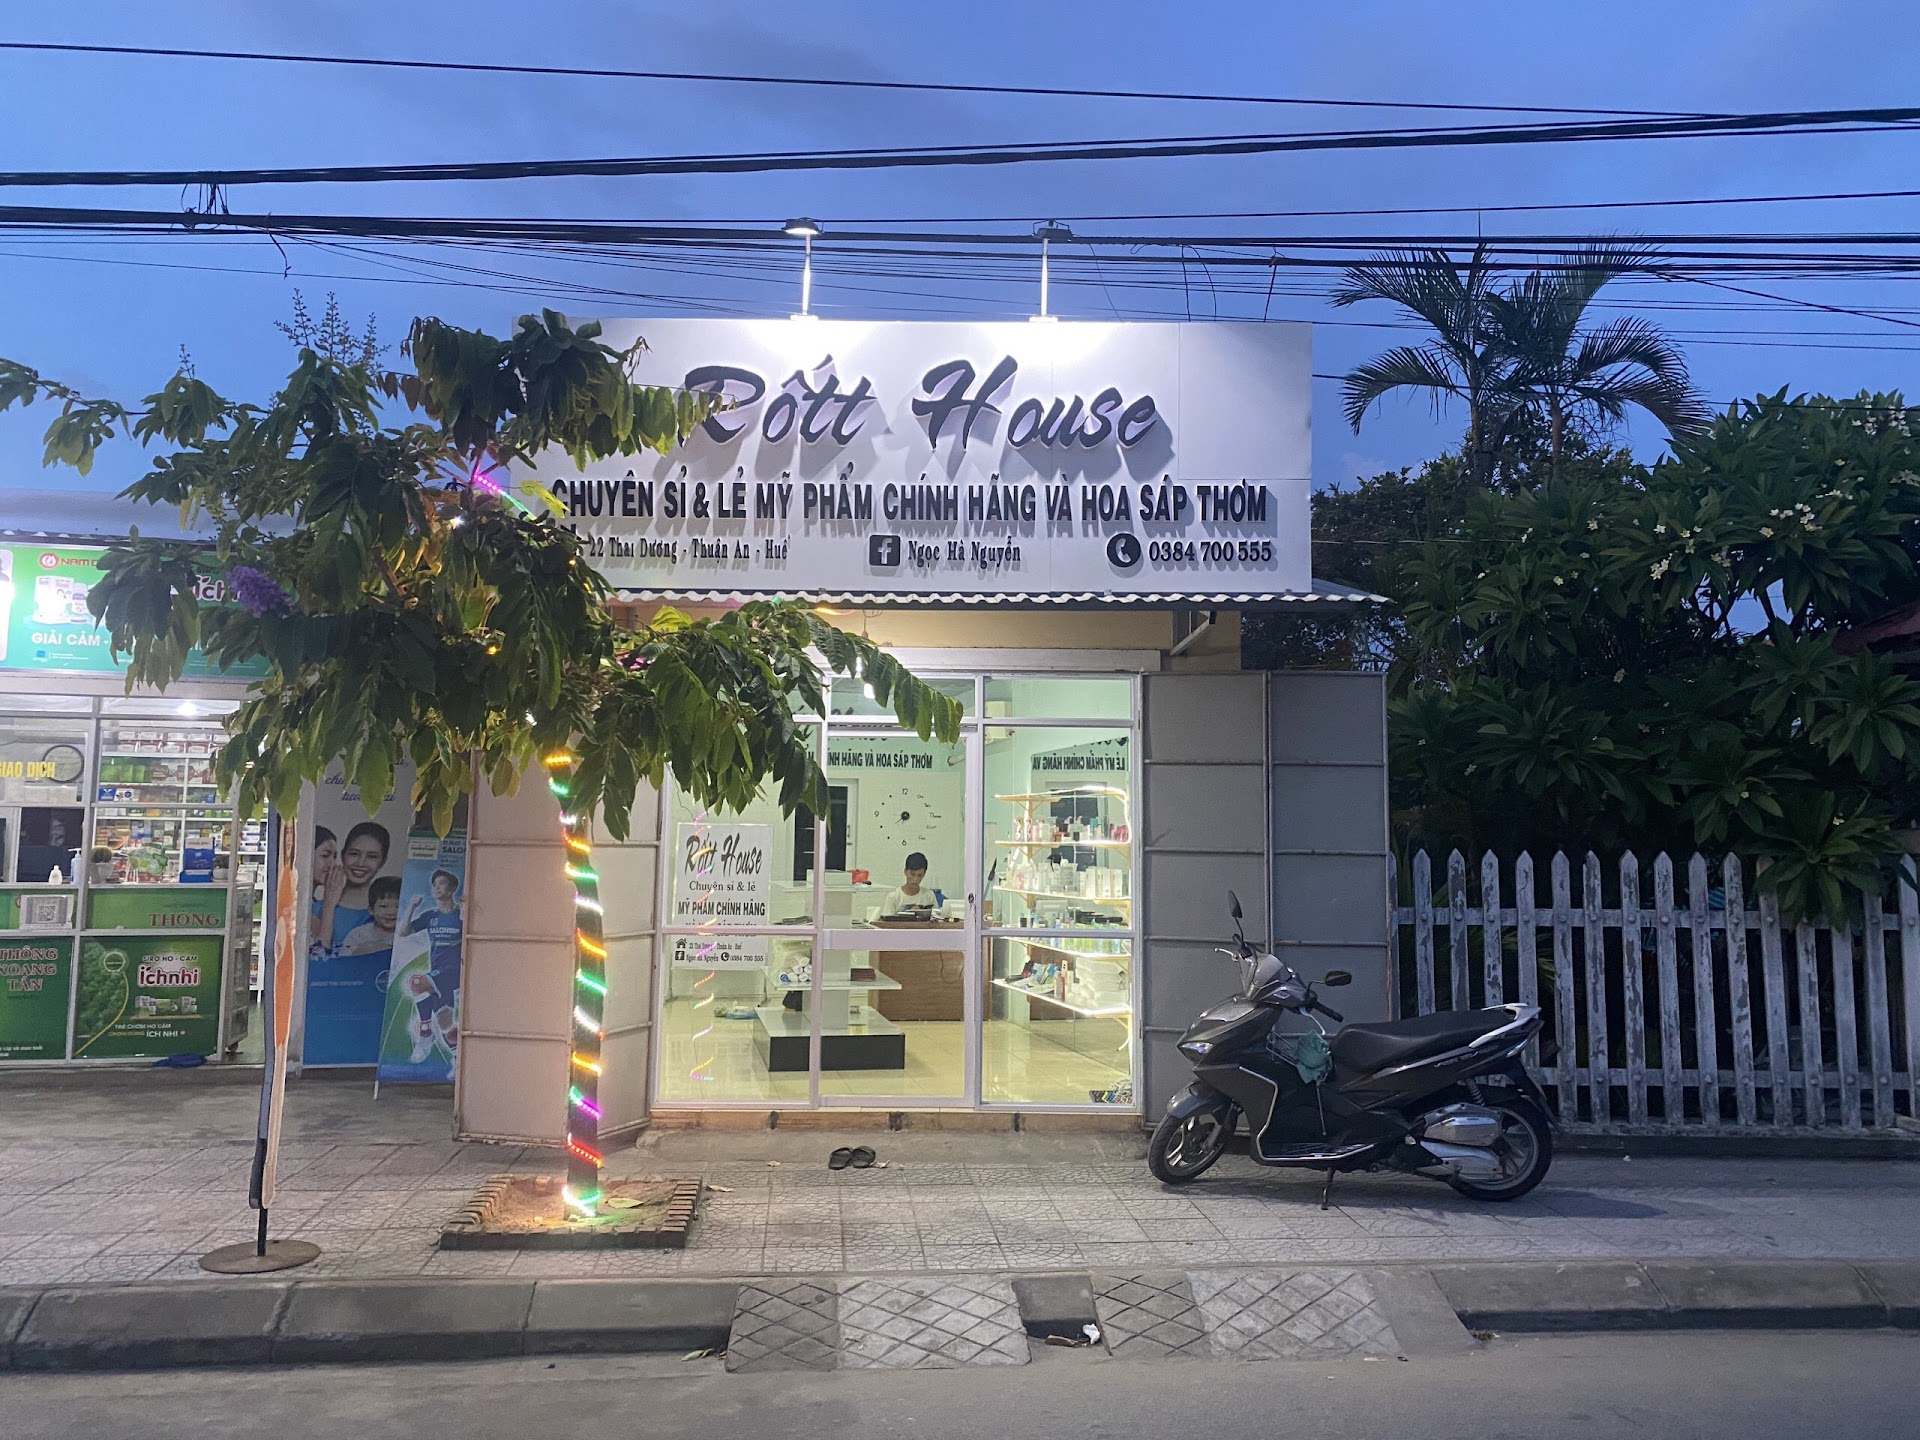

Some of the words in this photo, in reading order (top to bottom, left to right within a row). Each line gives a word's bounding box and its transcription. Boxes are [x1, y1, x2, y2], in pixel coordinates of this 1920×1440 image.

[912, 354, 1157, 450] House
[552, 470, 653, 516] CHUYÊN
[664, 465, 687, 518] SỈ
[693, 482, 710, 518] &
[718, 466, 746, 518] LẺ
[756, 471, 793, 519] MỸ
[803, 461, 872, 520] PHẨM
[883, 473, 958, 520] CHÍNH
[968, 473, 1036, 521] HÃNG
[1045, 473, 1072, 521] VÀ
[1082, 485, 1131, 521] HOA
[1139, 474, 1187, 521] SÁP
[1197, 478, 1267, 522] THƠM
[590, 536, 604, 557] 22
[639, 538, 678, 565] Dương
[691, 537, 728, 564] Thuận
[734, 538, 750, 559] An
[908, 540, 940, 568] Ngọc
[947, 539, 965, 561] Hà
[971, 535, 1021, 569] Nguyễn
[1149, 541, 1195, 562] 0384
[1200, 541, 1233, 562] 700
[1238, 540, 1272, 562] 555
[876, 753, 892, 768] HOA
[894, 750, 909, 768] SÁP
[721, 832, 762, 877] House
[737, 882, 745, 892] &
[716, 898, 741, 916] CHÍNH
